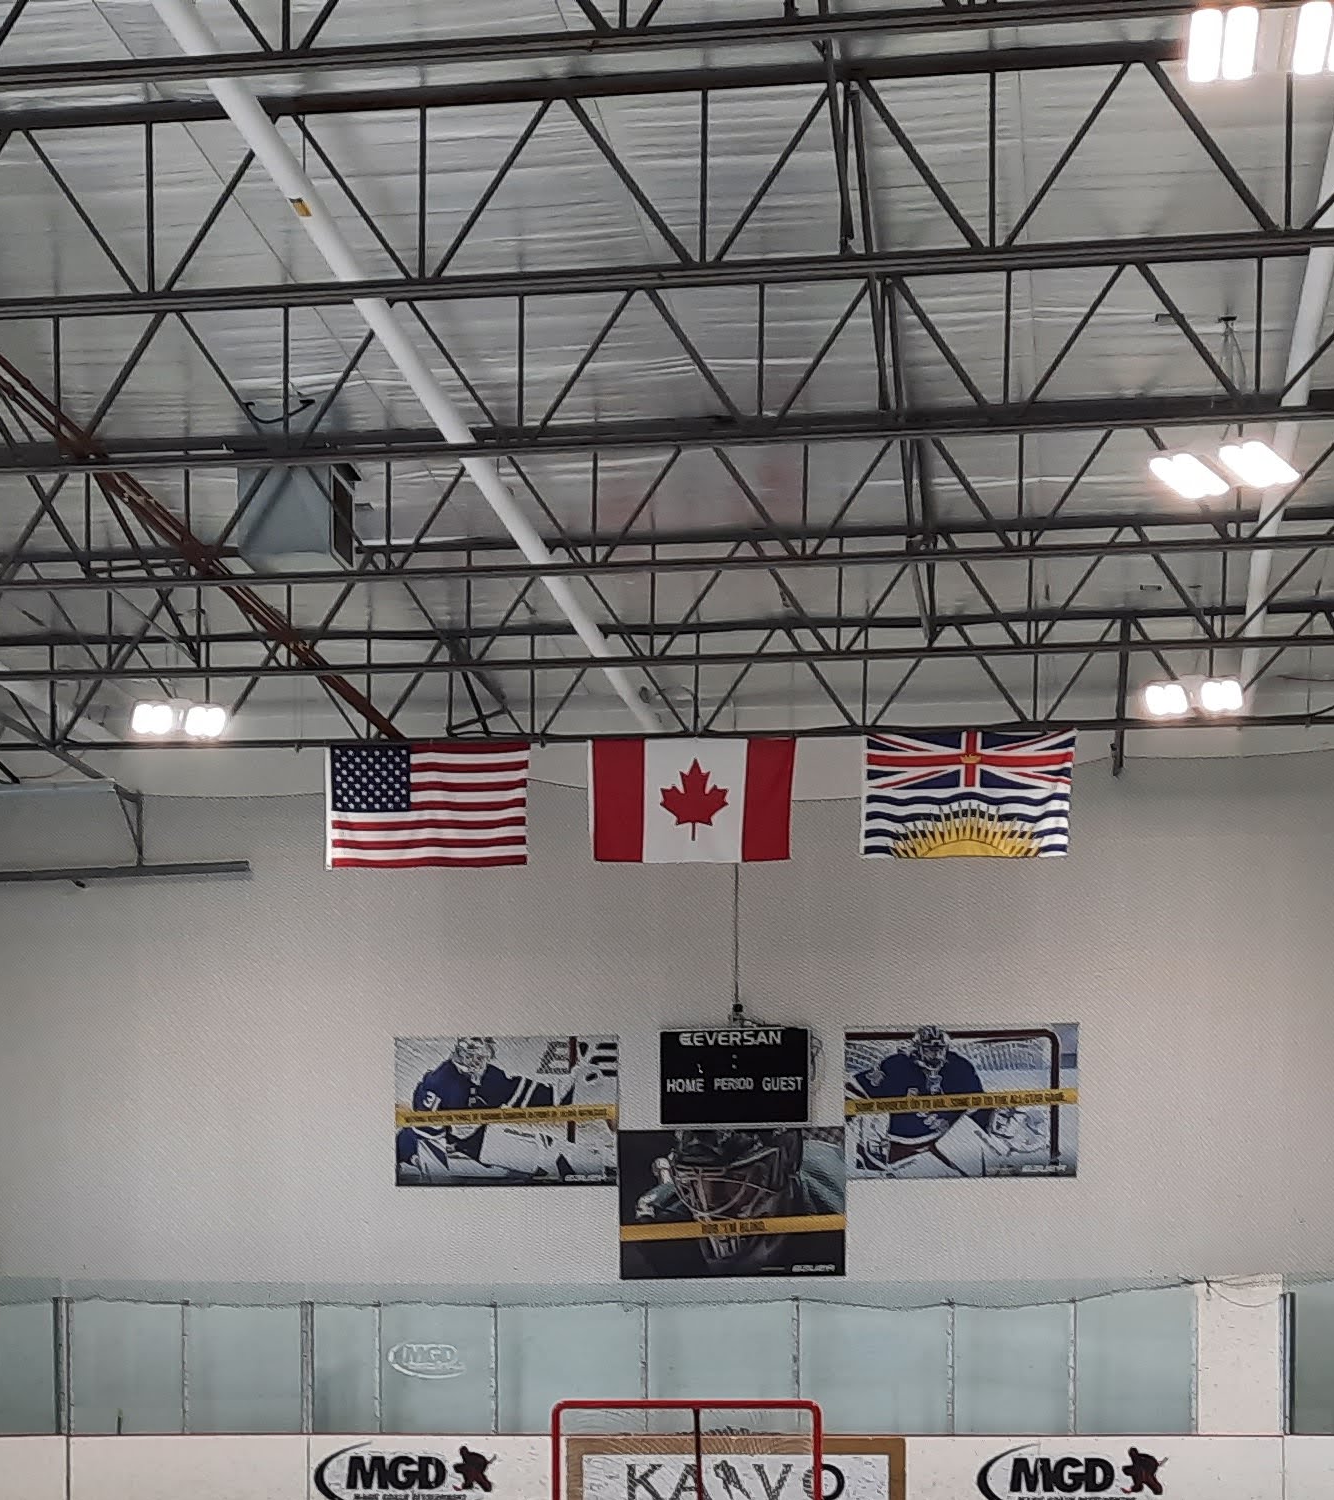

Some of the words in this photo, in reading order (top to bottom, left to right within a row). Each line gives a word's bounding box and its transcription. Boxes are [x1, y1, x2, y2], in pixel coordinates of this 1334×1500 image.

[693, 1031, 782, 1046] EVERSAN
[666, 1078, 705, 1093] HOME
[713, 1077, 754, 1091] PERIOD
[761, 1076, 804, 1091] GUEST
[346, 1456, 447, 1490] MGD
[1009, 1457, 1115, 1492] MGD
